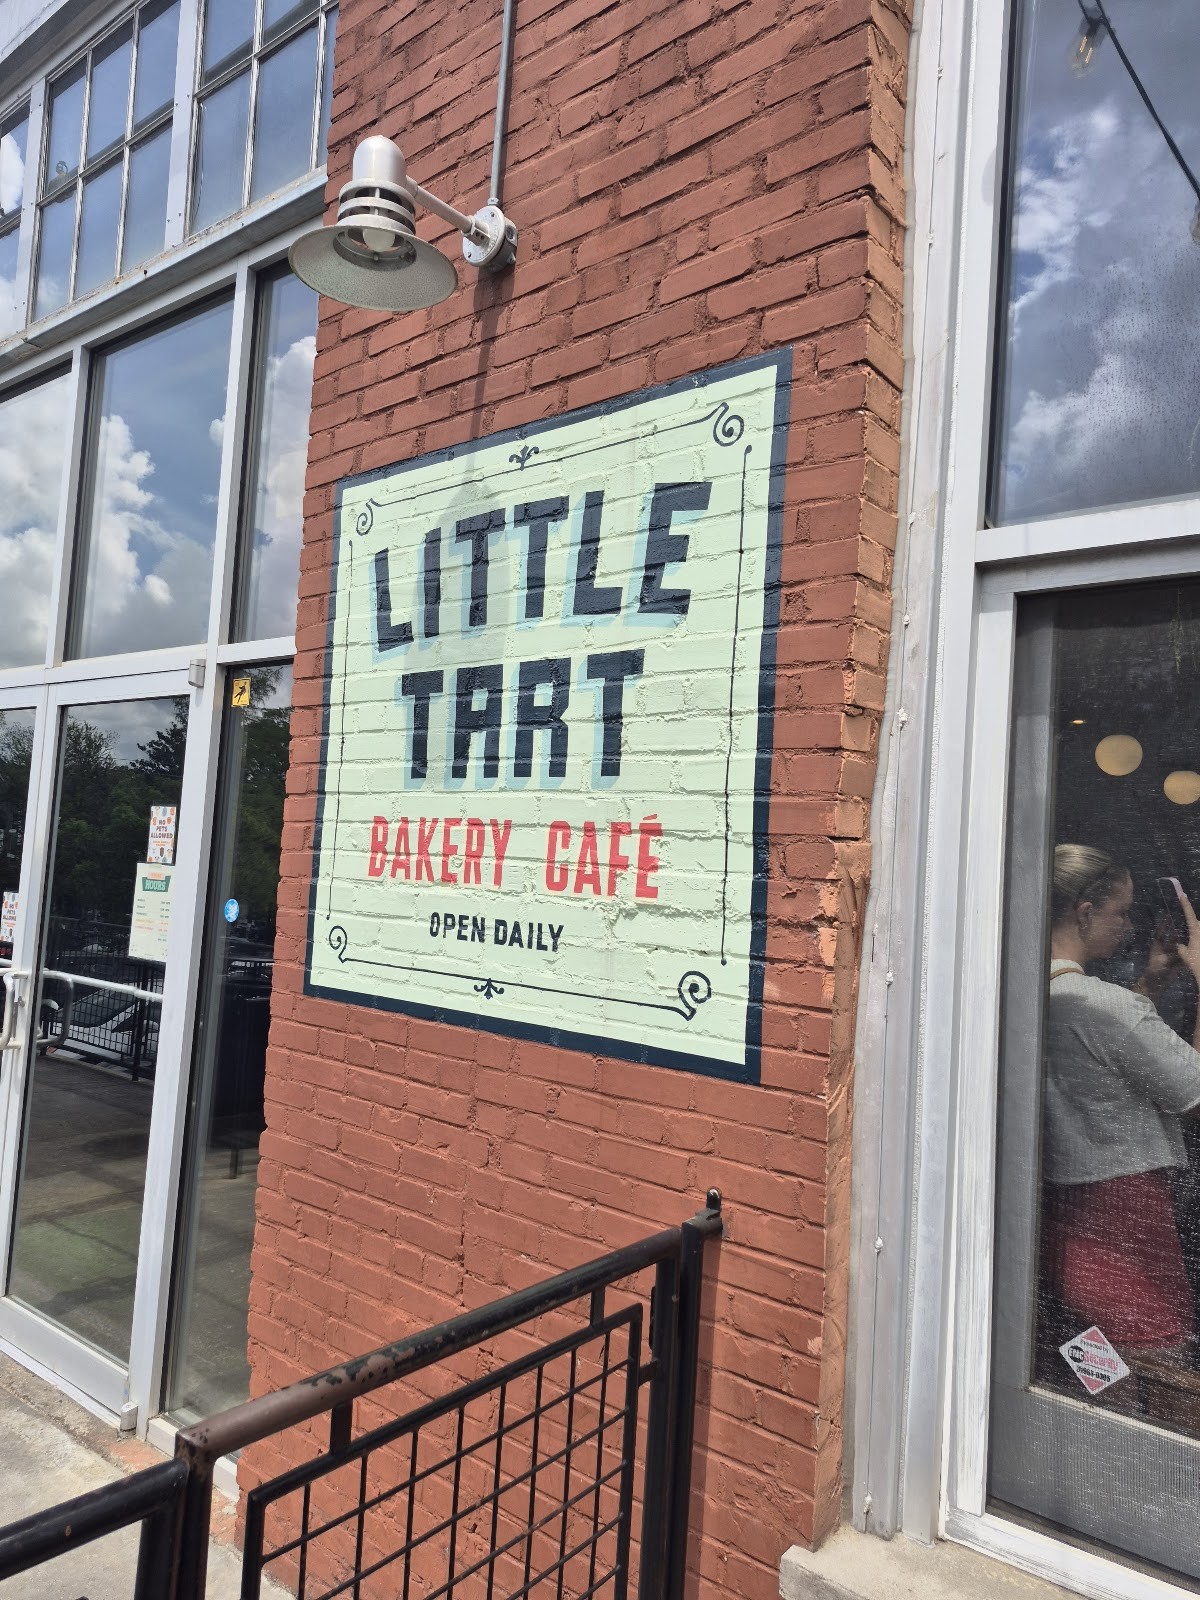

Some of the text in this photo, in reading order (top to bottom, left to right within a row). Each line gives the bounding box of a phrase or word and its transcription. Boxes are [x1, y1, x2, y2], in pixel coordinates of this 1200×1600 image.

[374, 481, 713, 654] LITTLE
[399, 649, 645, 780] TART
[144, 880, 167, 891] HOURS
[368, 813, 663, 899] BAKERY CAFÉ
[429, 911, 564, 952] OPEN DAILY
